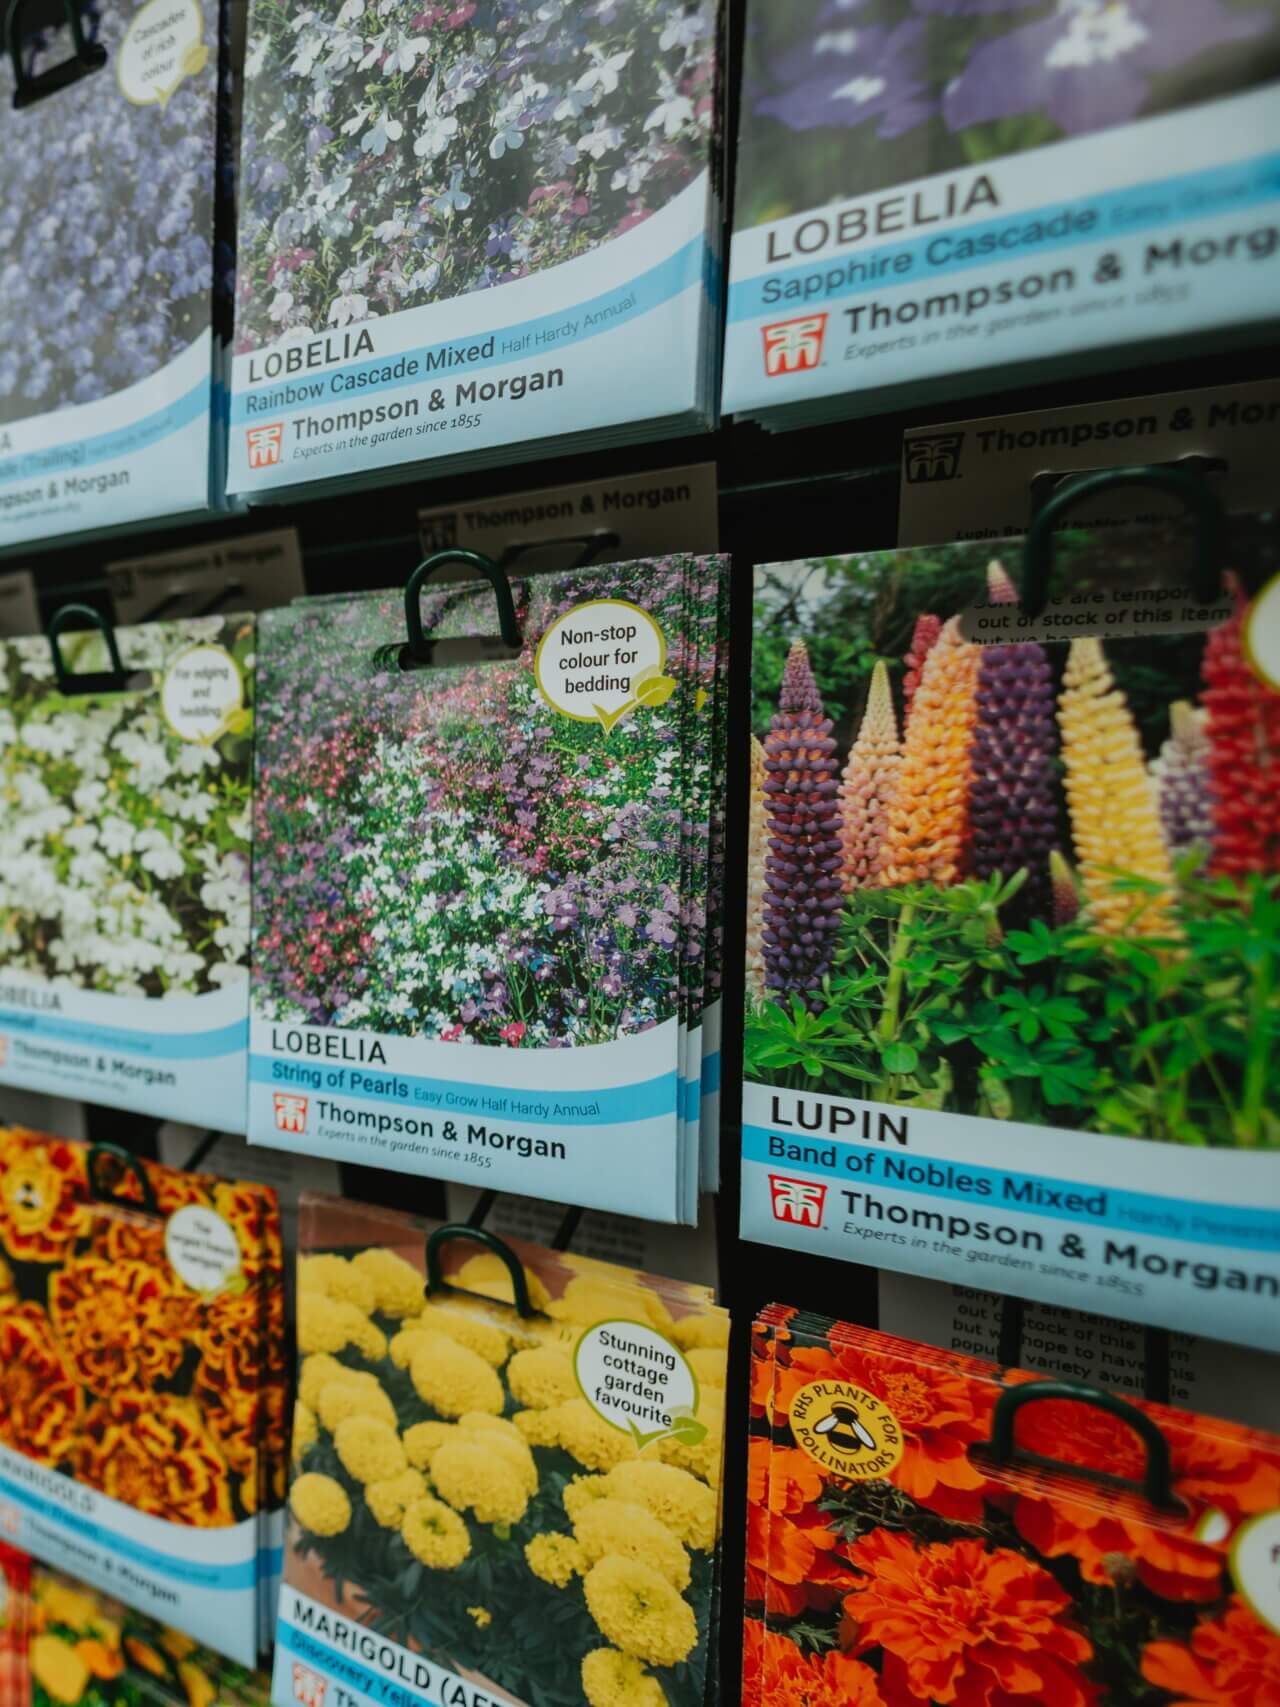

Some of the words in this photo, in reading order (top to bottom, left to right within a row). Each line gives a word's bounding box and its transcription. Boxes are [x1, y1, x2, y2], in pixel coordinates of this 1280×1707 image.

[766, 175, 999, 263] LOBELIA
[761, 251, 913, 304] Sapphire
[925, 209, 1098, 267] Cascade
[843, 264, 1075, 335] Thompson
[1093, 252, 1121, 286] &
[245, 379, 325, 415] Rainbow
[330, 357, 419, 394] Cascade
[425, 336, 495, 373] Mixed
[501, 335, 532, 356] Half
[535, 321, 579, 348] Hardy
[583, 292, 638, 329] Annual
[248, 328, 376, 383] LOBELIA
[843, 332, 916, 362] Experts
[920, 328, 936, 347] in
[943, 319, 979, 343] the
[292, 394, 419, 441] Thompson
[428, 388, 445, 412] &
[455, 365, 565, 407] Morgan
[292, 438, 334, 461] Experts
[336, 436, 347, 452] in
[348, 433, 368, 450] the
[370, 423, 413, 448] garden
[415, 417, 448, 437] since
[450, 413, 482, 433] 1855
[976, 414, 1158, 453] Thompson
[1168, 406, 1194, 432] &
[47, 482, 58, 499] &
[63, 470, 130, 494] Morgan
[464, 502, 574, 533] Thompson
[579, 494, 597, 515] &
[602, 483, 691, 512] Morgan
[561, 625, 637, 646] Non-stop
[978, 616, 1009, 630] out
[1043, 611, 1098, 627] stock
[1105, 608, 1126, 625] of
[1133, 606, 1172, 624] this
[1180, 605, 1231, 622] item
[559, 653, 610, 670] colour
[615, 648, 638, 665] for
[565, 675, 630, 694] bedding
[12, 1038, 90, 1066] Thompson
[95, 1055, 107, 1072] &
[112, 1059, 177, 1088] Morgan
[272, 1028, 387, 1065] LOBELIA
[271, 1061, 322, 1089] String
[326, 1069, 346, 1089] of
[350, 1071, 409, 1099] Pearls
[414, 1087, 443, 1107] Easy
[445, 1092, 479, 1110] Grow
[481, 1095, 508, 1112] Half
[511, 1099, 550, 1119] Hardy
[552, 1101, 601, 1116] Annual
[316, 1100, 434, 1141] Thompson
[442, 1120, 458, 1142] &
[467, 1124, 567, 1160] Morgan
[771, 1095, 909, 1146] LUPIN
[317, 1125, 355, 1145] Experts
[357, 1132, 368, 1145] in
[369, 1133, 388, 1149] the
[390, 1139, 430, 1157] garden
[431, 1145, 461, 1161] since
[463, 1151, 492, 1169] 1855
[768, 1136, 837, 1168] Band
[846, 1150, 875, 1175] of
[884, 1157, 993, 1197] Nobles
[1003, 1174, 1108, 1218] Mixed
[840, 1189, 1045, 1252] Thompson
[1060, 1231, 1087, 1260] &
[1103, 1239, 1280, 1299] Morgan
[842, 1221, 907, 1247] Experts
[911, 1234, 928, 1250] in
[932, 1238, 963, 1259] the
[967, 1246, 1036, 1272] garden
[1040, 1257, 1091, 1284] since
[1097, 1271, 1145, 1297] 1855
[599, 1330, 676, 1371] Stunning
[953, 1318, 983, 1336] but
[1023, 1335, 1069, 1355] hope
[1075, 1345, 1094, 1361] to
[1101, 1350, 1145, 1371] have
[958, 1302, 988, 1320] out
[1074, 1328, 1095, 1343] of
[1099, 1331, 1137, 1351] this
[603, 1354, 669, 1385] cottage
[604, 1374, 664, 1404] garden
[951, 1337, 1001, 1357] popul
[1025, 1353, 1091, 1379] variety
[1099, 1369, 1190, 1400] availle
[595, 1387, 672, 1427] favourite
[793, 1392, 814, 1420] RHS
[813, 1383, 880, 1412] PLANTS
[877, 1415, 898, 1445] FOR
[796, 1427, 895, 1475] POLLINATORS
[294, 1599, 431, 1690] MARIGOLD
